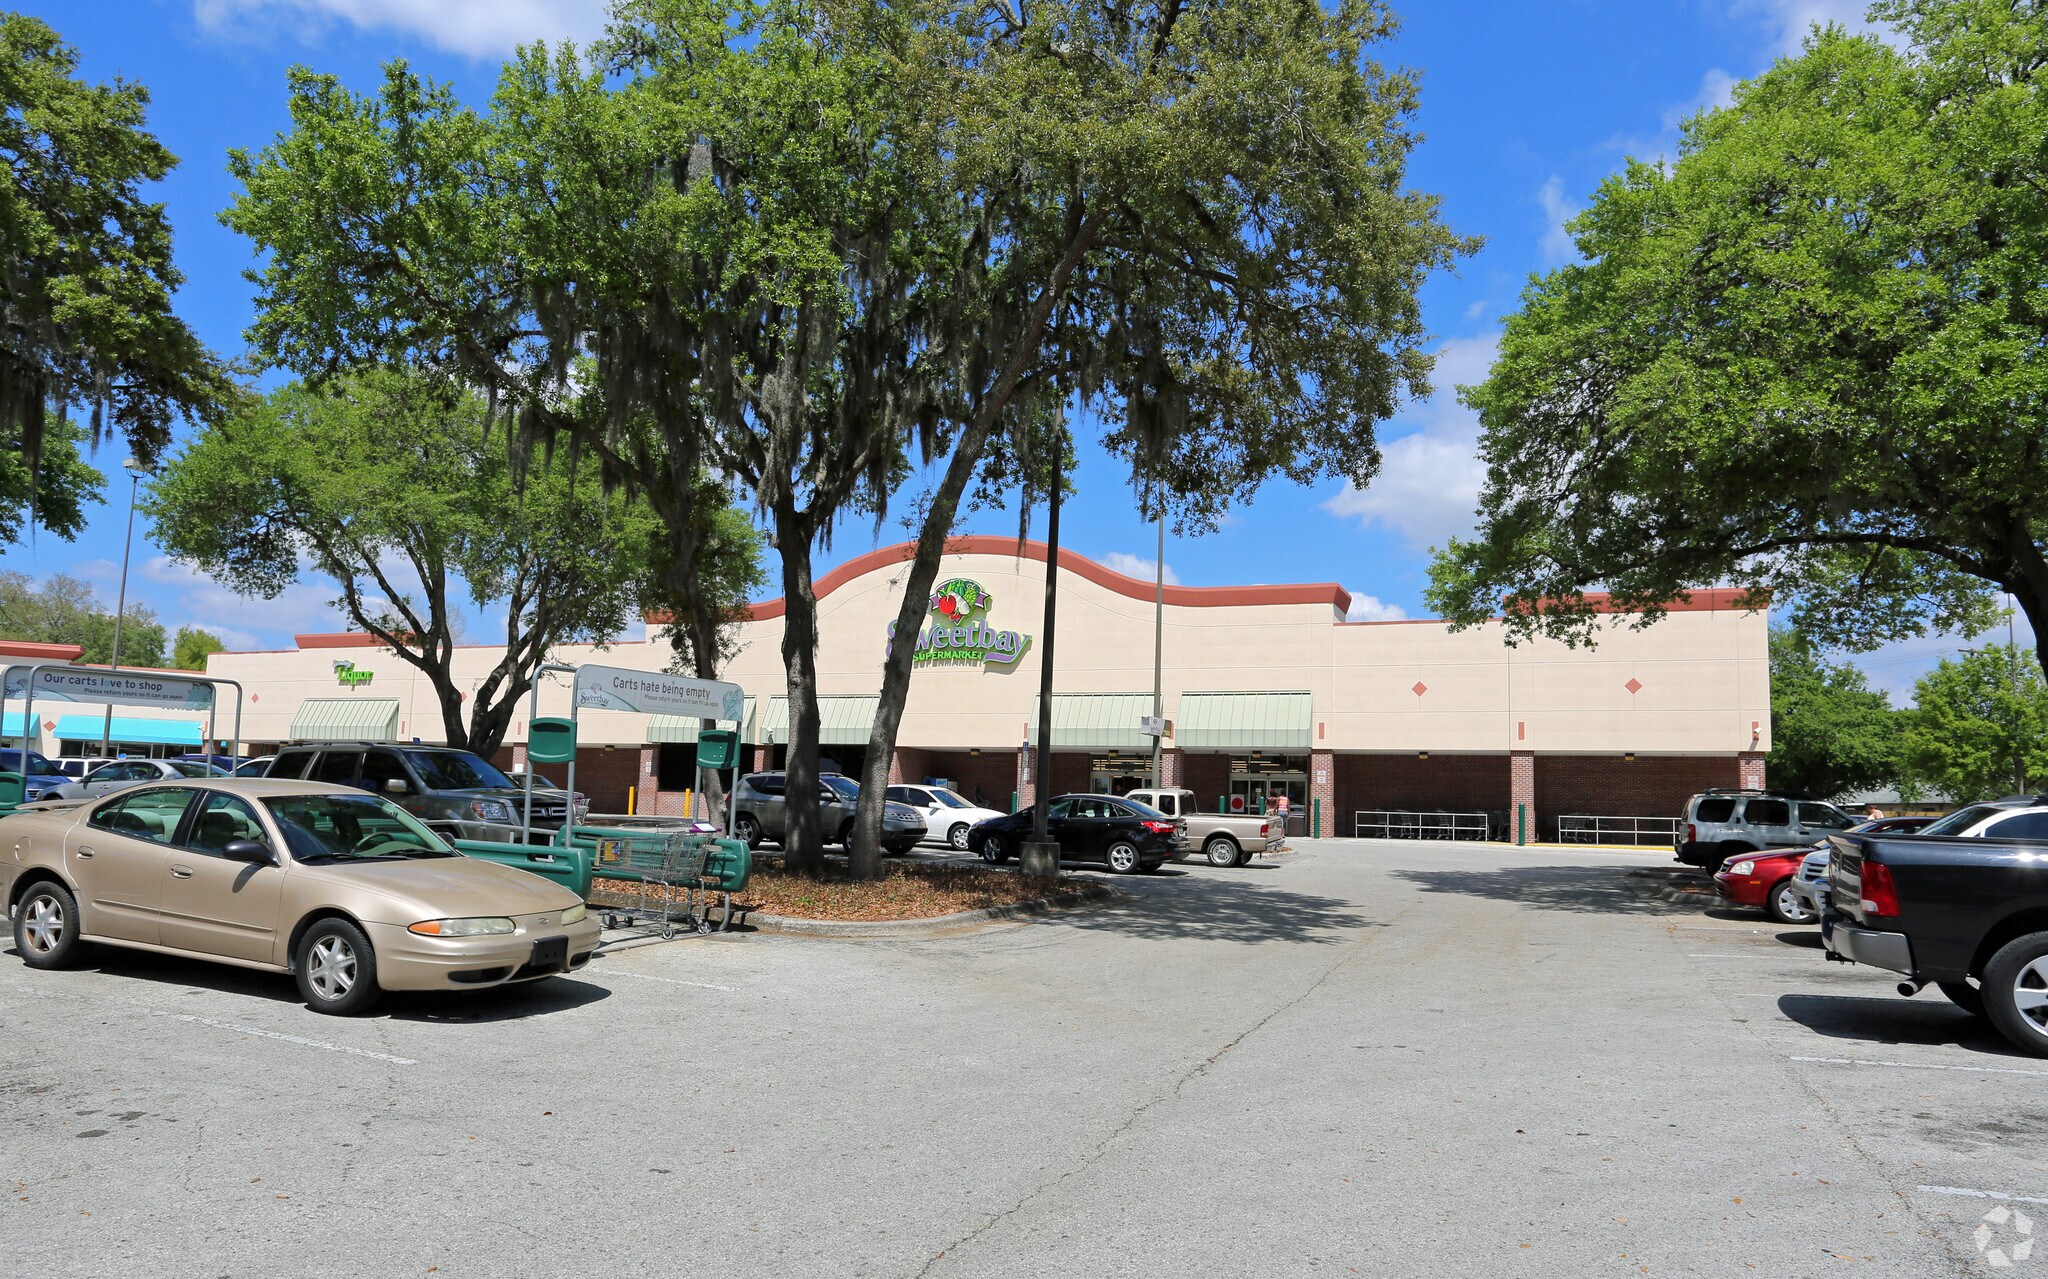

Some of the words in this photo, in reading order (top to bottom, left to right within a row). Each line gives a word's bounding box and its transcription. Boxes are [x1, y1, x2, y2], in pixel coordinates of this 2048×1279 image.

[913, 650, 984, 662] SUPERMARKET
[44, 673, 65, 684] Our
[68, 677, 97, 686] carts
[125, 680, 136, 689] to
[138, 681, 163, 692] shop
[337, 666, 372, 685] Liquor
[613, 676, 638, 690] Carts
[640, 680, 659, 692] hate
[662, 681, 684, 697] being
[685, 687, 711, 700] empty
[581, 692, 609, 706] Sweetbay
